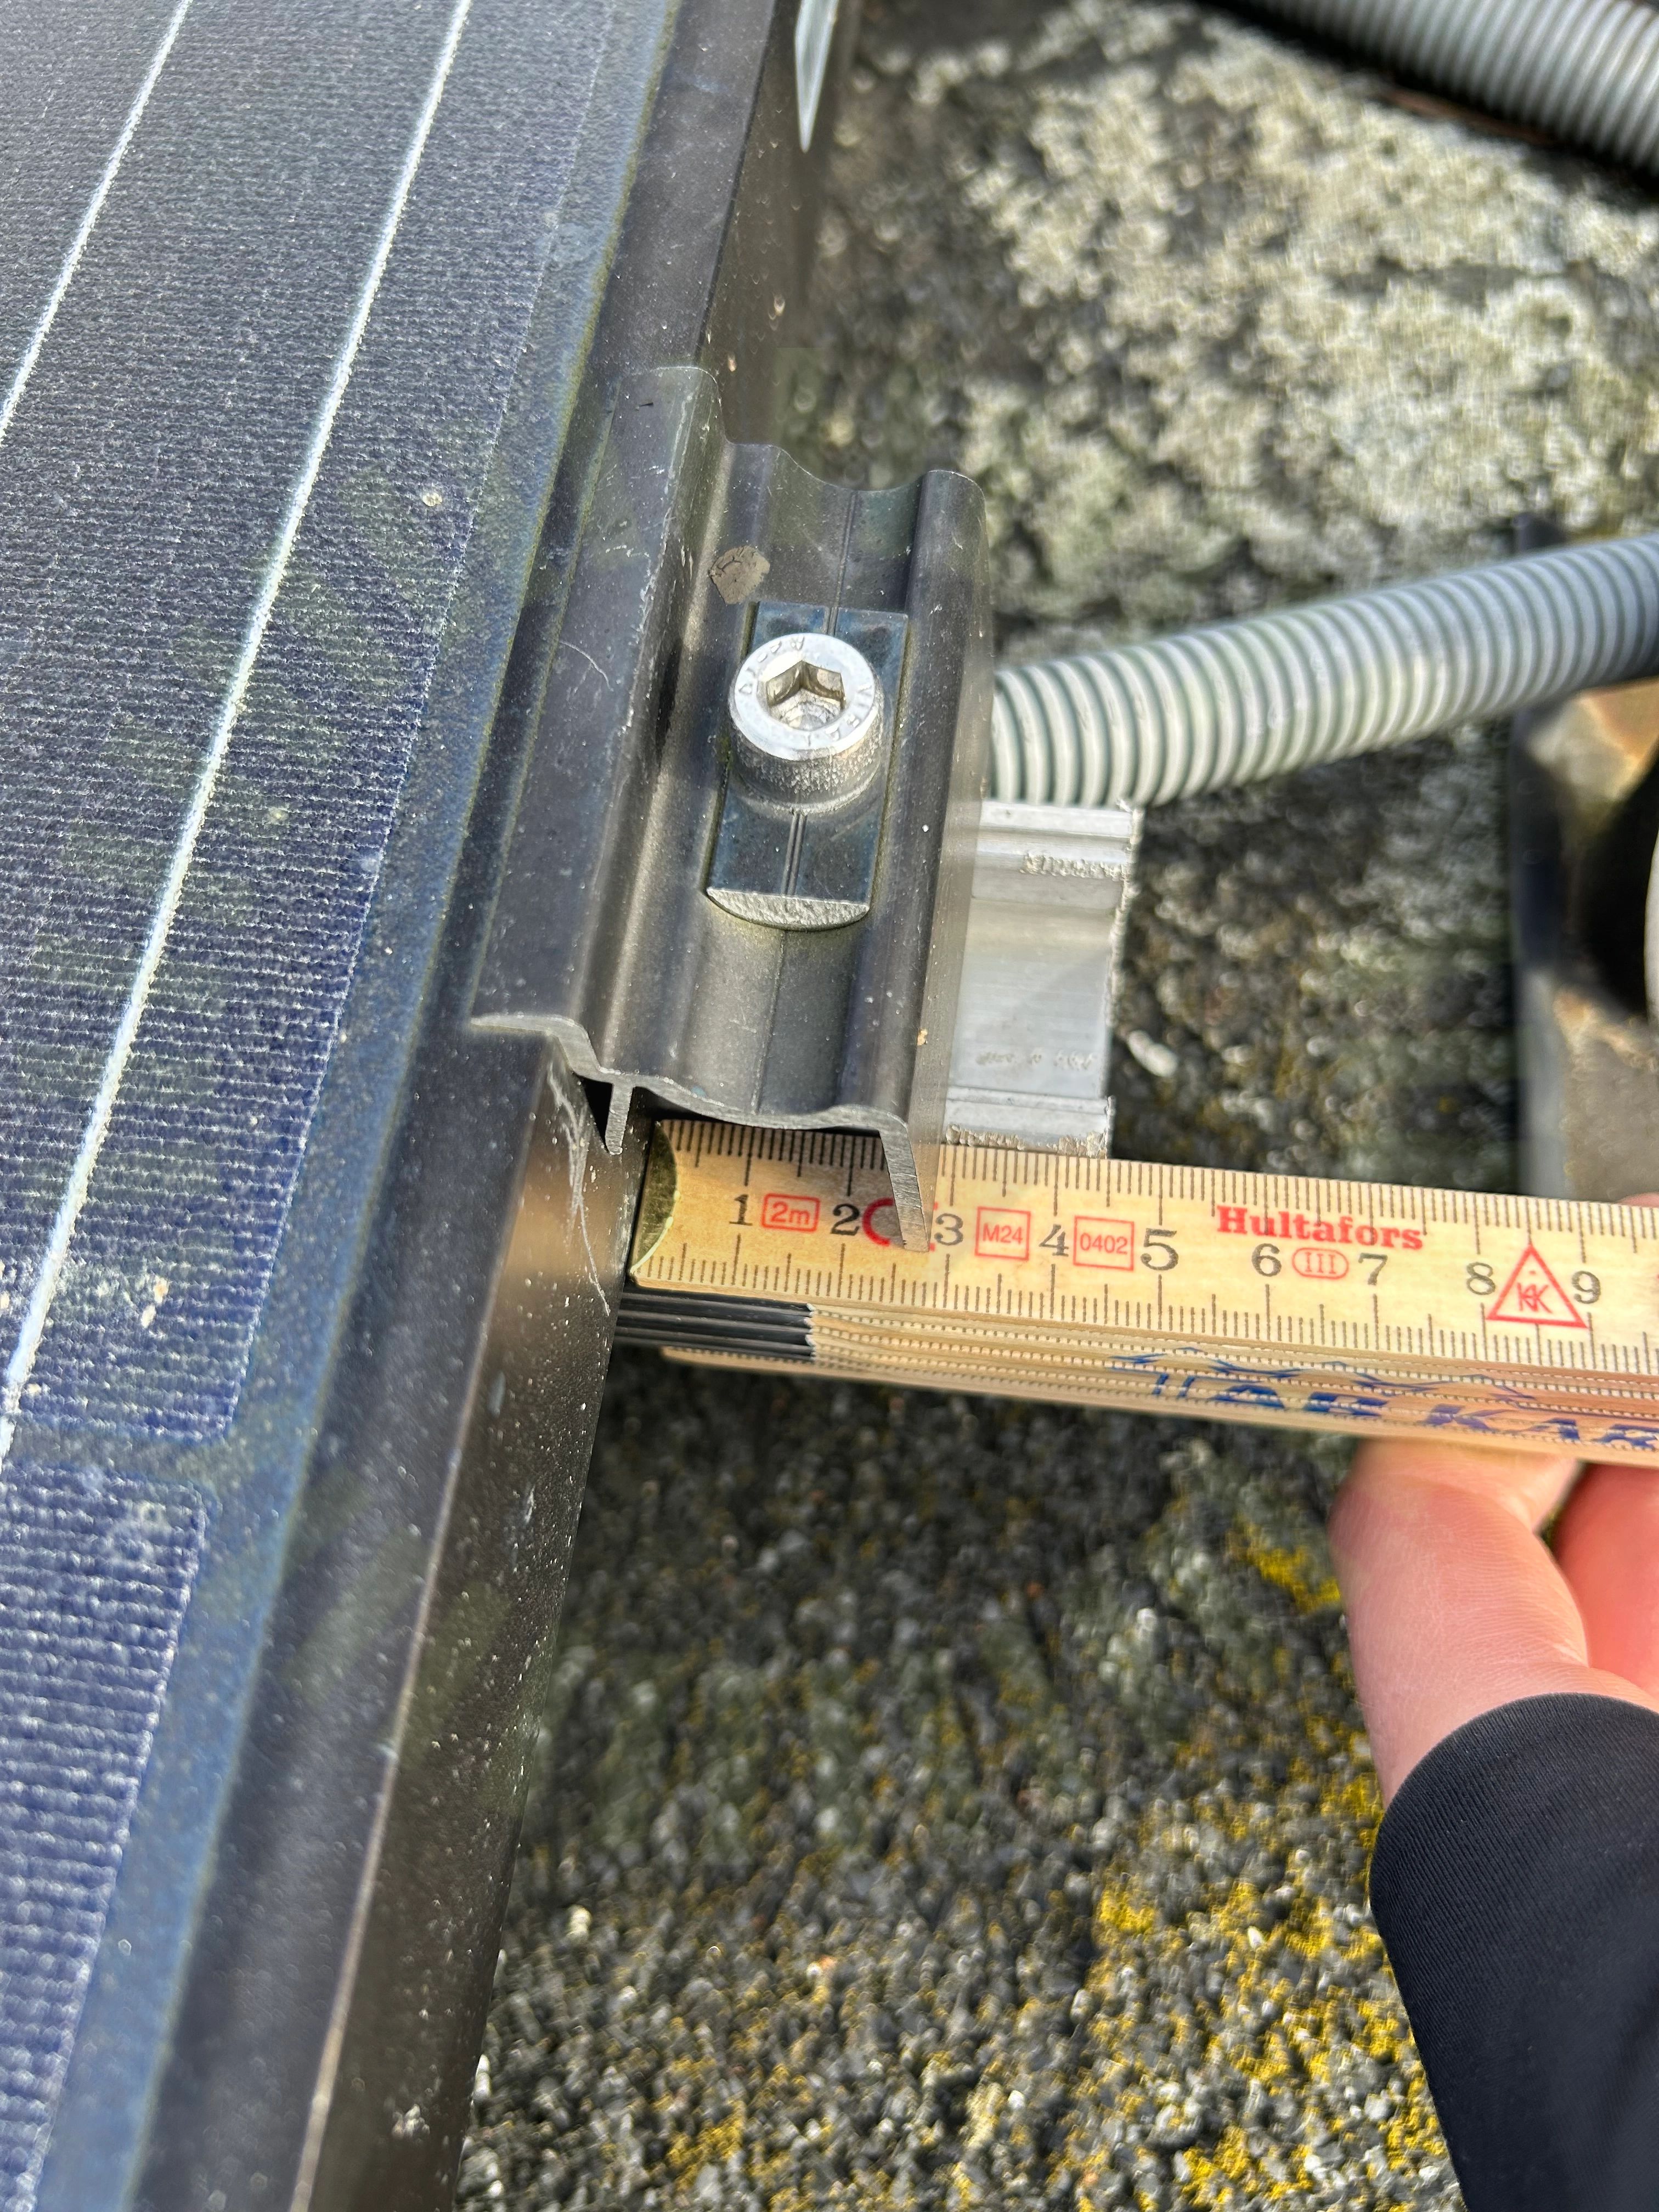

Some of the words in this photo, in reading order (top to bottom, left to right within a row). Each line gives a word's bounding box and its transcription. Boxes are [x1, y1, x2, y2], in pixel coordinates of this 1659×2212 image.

[729, 1194, 753, 1226] 1
[770, 1203, 810, 1225] 2m
[831, 1204, 860, 1236] 2
[934, 1213, 963, 1245] 3
[983, 1224, 1023, 1245] M24
[1039, 1224, 1069, 1257] 4
[1217, 1205, 1423, 1250] Hultafors
[1080, 1233, 1128, 1255] 0402
[1141, 1228, 1178, 1271] 5
[1251, 1243, 1282, 1277] 6
[1305, 1252, 1336, 1274] III
[1358, 1252, 1388, 1285] 7
[1466, 1262, 1496, 1295] 8
[1571, 1271, 1601, 1304] 9
